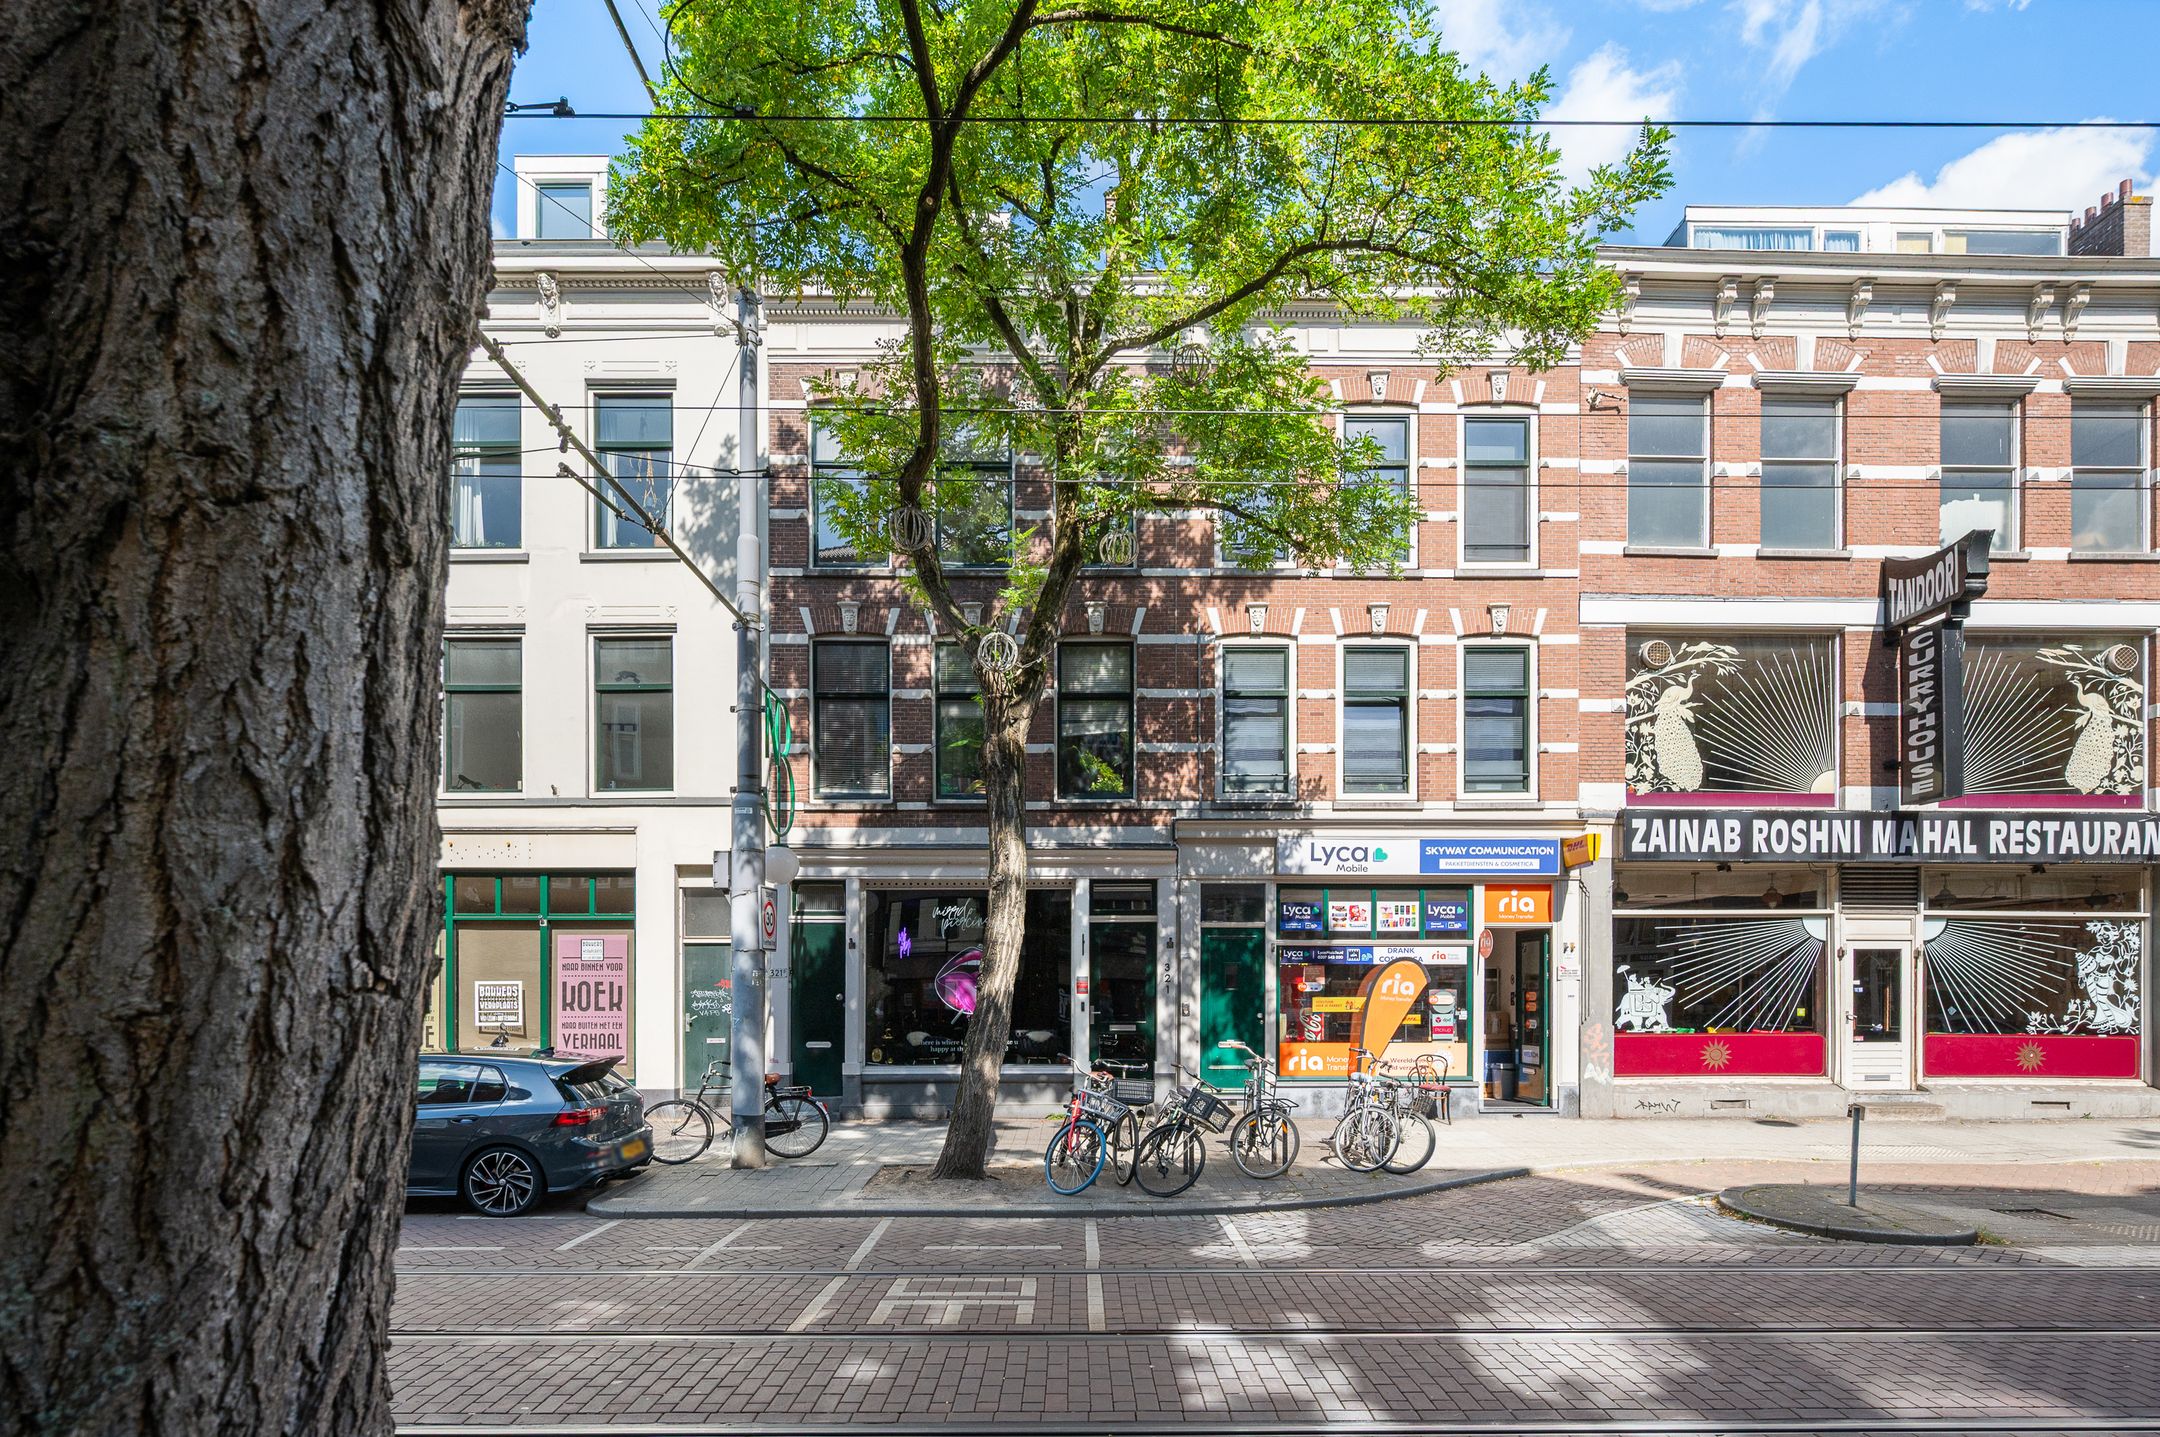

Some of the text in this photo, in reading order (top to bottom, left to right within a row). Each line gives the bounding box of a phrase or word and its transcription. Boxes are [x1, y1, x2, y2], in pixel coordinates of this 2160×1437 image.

[1888, 544, 1959, 623] TANDOORI
[1631, 818, 1741, 853] ZAINAB
[1752, 819, 1861, 854] ROSHNI
[1872, 820, 1977, 854] MAHAL
[1311, 842, 1368, 866] Lyca
[1425, 846, 1554, 855] SKYWAY COMMUNICATION
[1336, 864, 1368, 873] Mobile
[1498, 889, 1535, 912] ria
[1283, 905, 1311, 916] Lyca
[1428, 904, 1456, 917] Lyca
[766, 912, 774, 926] 30
[1283, 950, 1304, 958] Lyca
[1432, 950, 1446, 960] ria
[562, 963, 623, 971] NAAR BINNEN VOOR
[1381, 973, 1415, 996] ria
[562, 1033, 623, 1050] VERHAAL
[1288, 1048, 1323, 1071] ria
